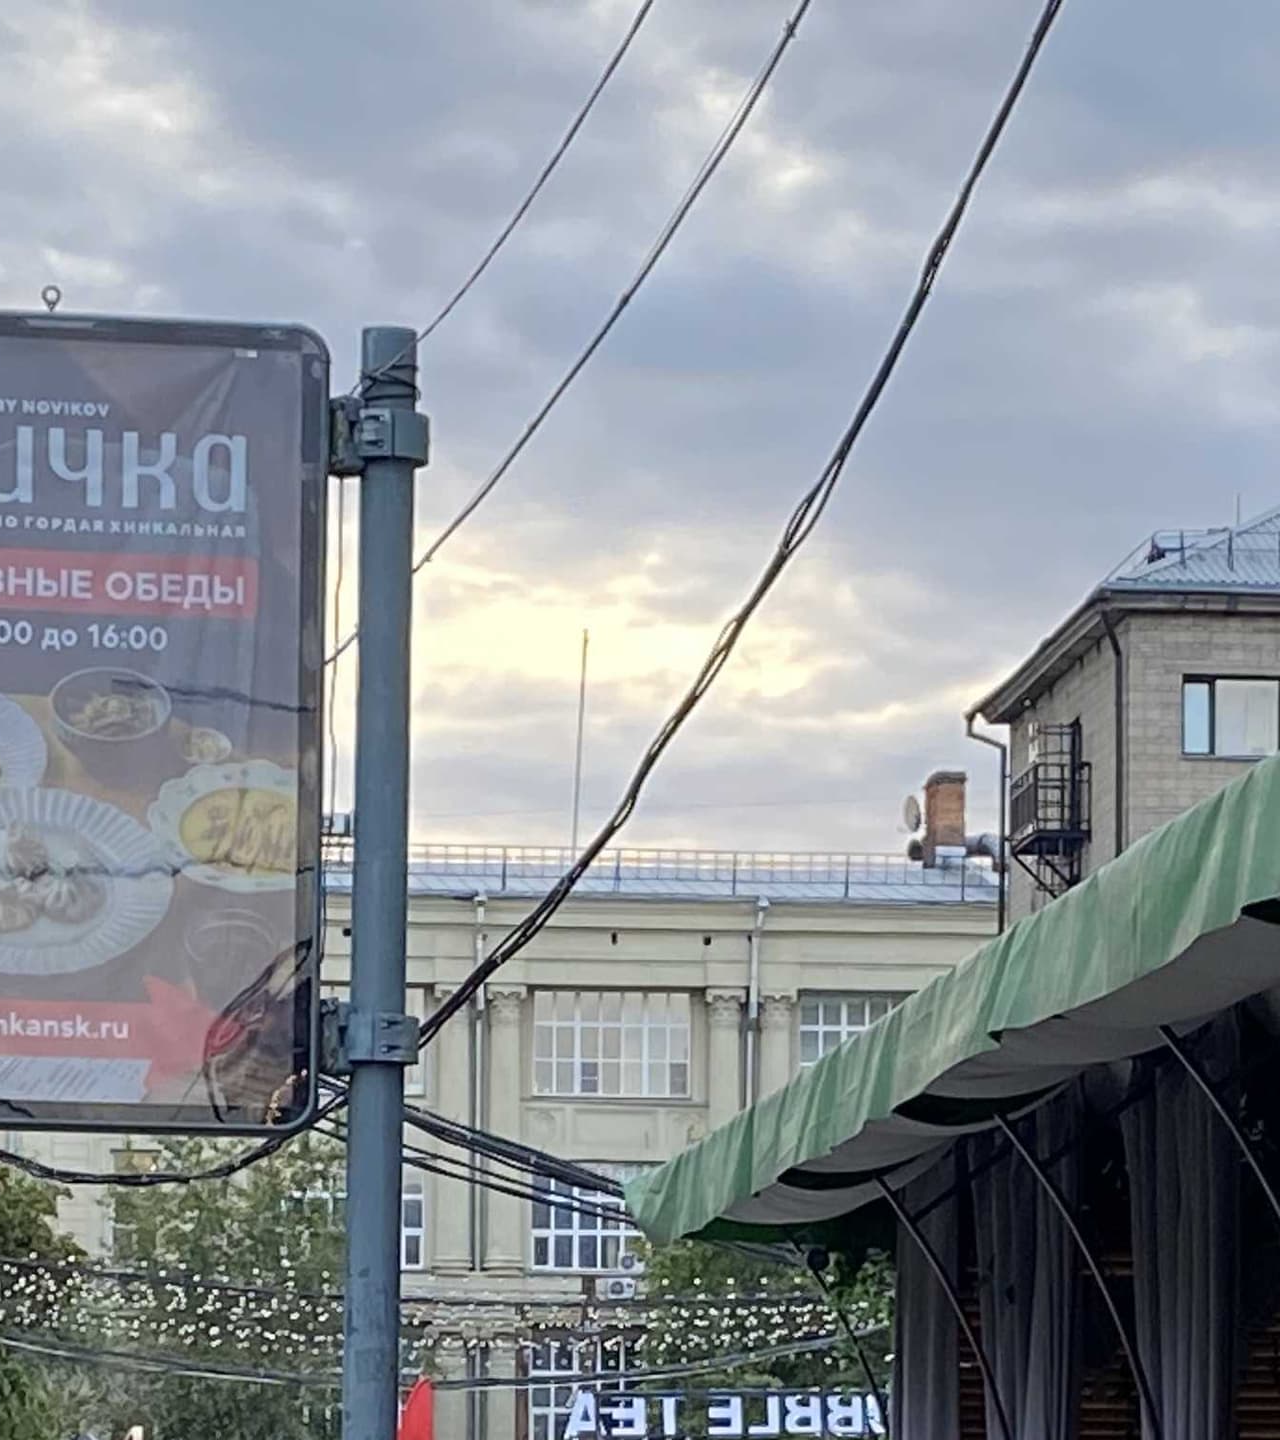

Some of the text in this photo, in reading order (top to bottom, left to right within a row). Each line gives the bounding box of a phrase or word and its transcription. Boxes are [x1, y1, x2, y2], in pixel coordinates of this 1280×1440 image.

[22, 400, 110, 417] NOVIKOV
[23, 515, 105, 534] ГОРДАЯ
[109, 519, 247, 539] ХИНКАЛЬНАЯ
[104, 570, 246, 611] ОБЕДЫ
[40, 627, 79, 651] до
[87, 623, 169, 651] 16:00
